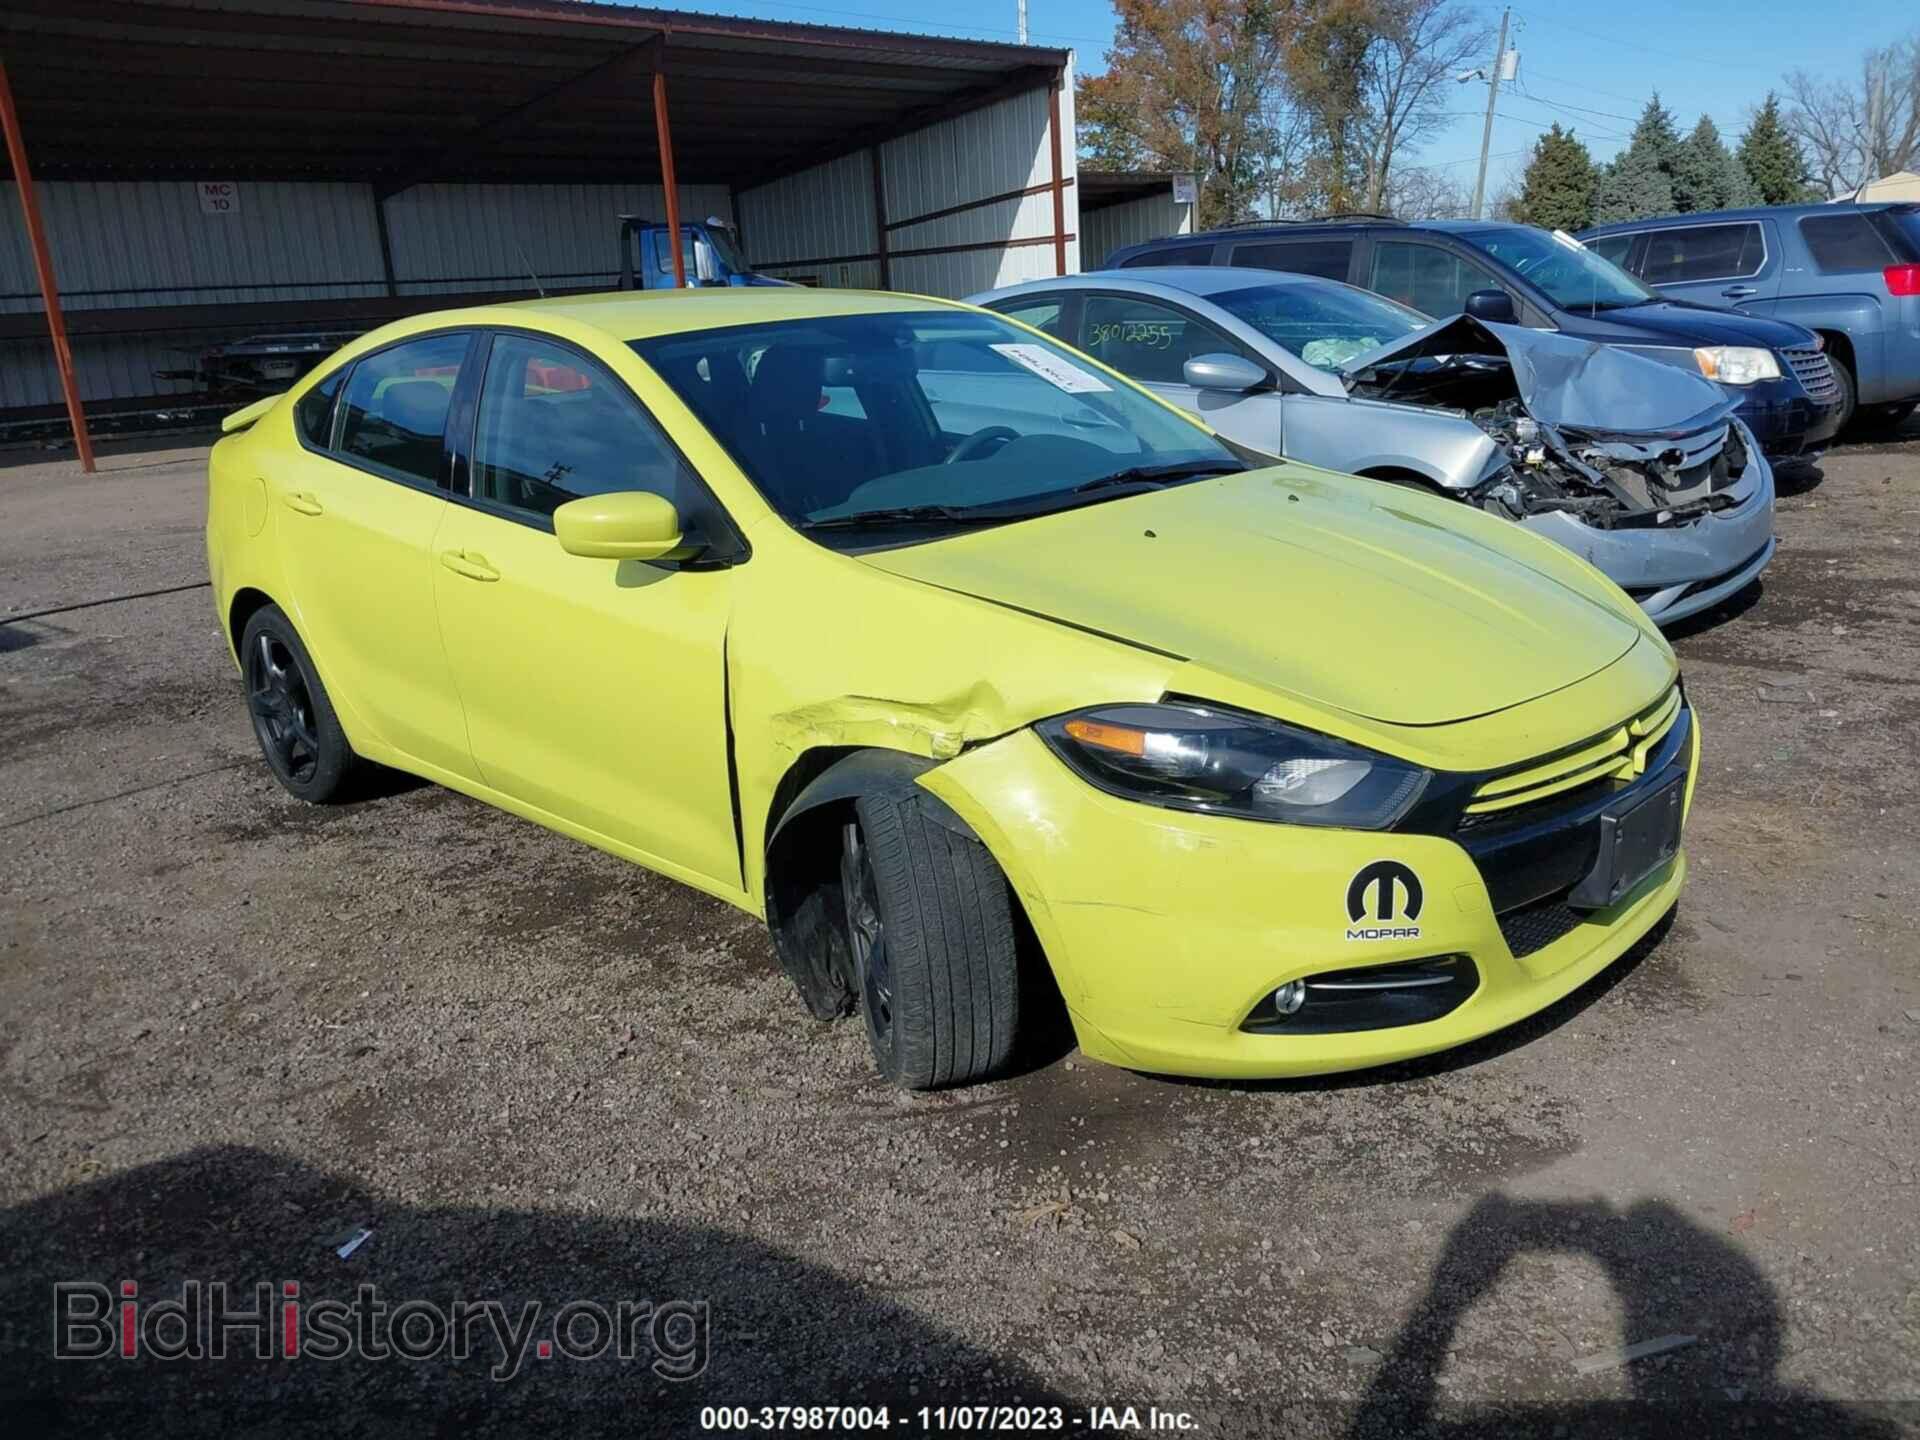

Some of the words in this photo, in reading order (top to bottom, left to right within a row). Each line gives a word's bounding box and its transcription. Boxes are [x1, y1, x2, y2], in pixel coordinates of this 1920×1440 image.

[205, 184, 232, 196] MC
[210, 199, 230, 210] 10
[1089, 323, 1172, 349] 38012255
[1346, 927, 1420, 939] MOPAR
